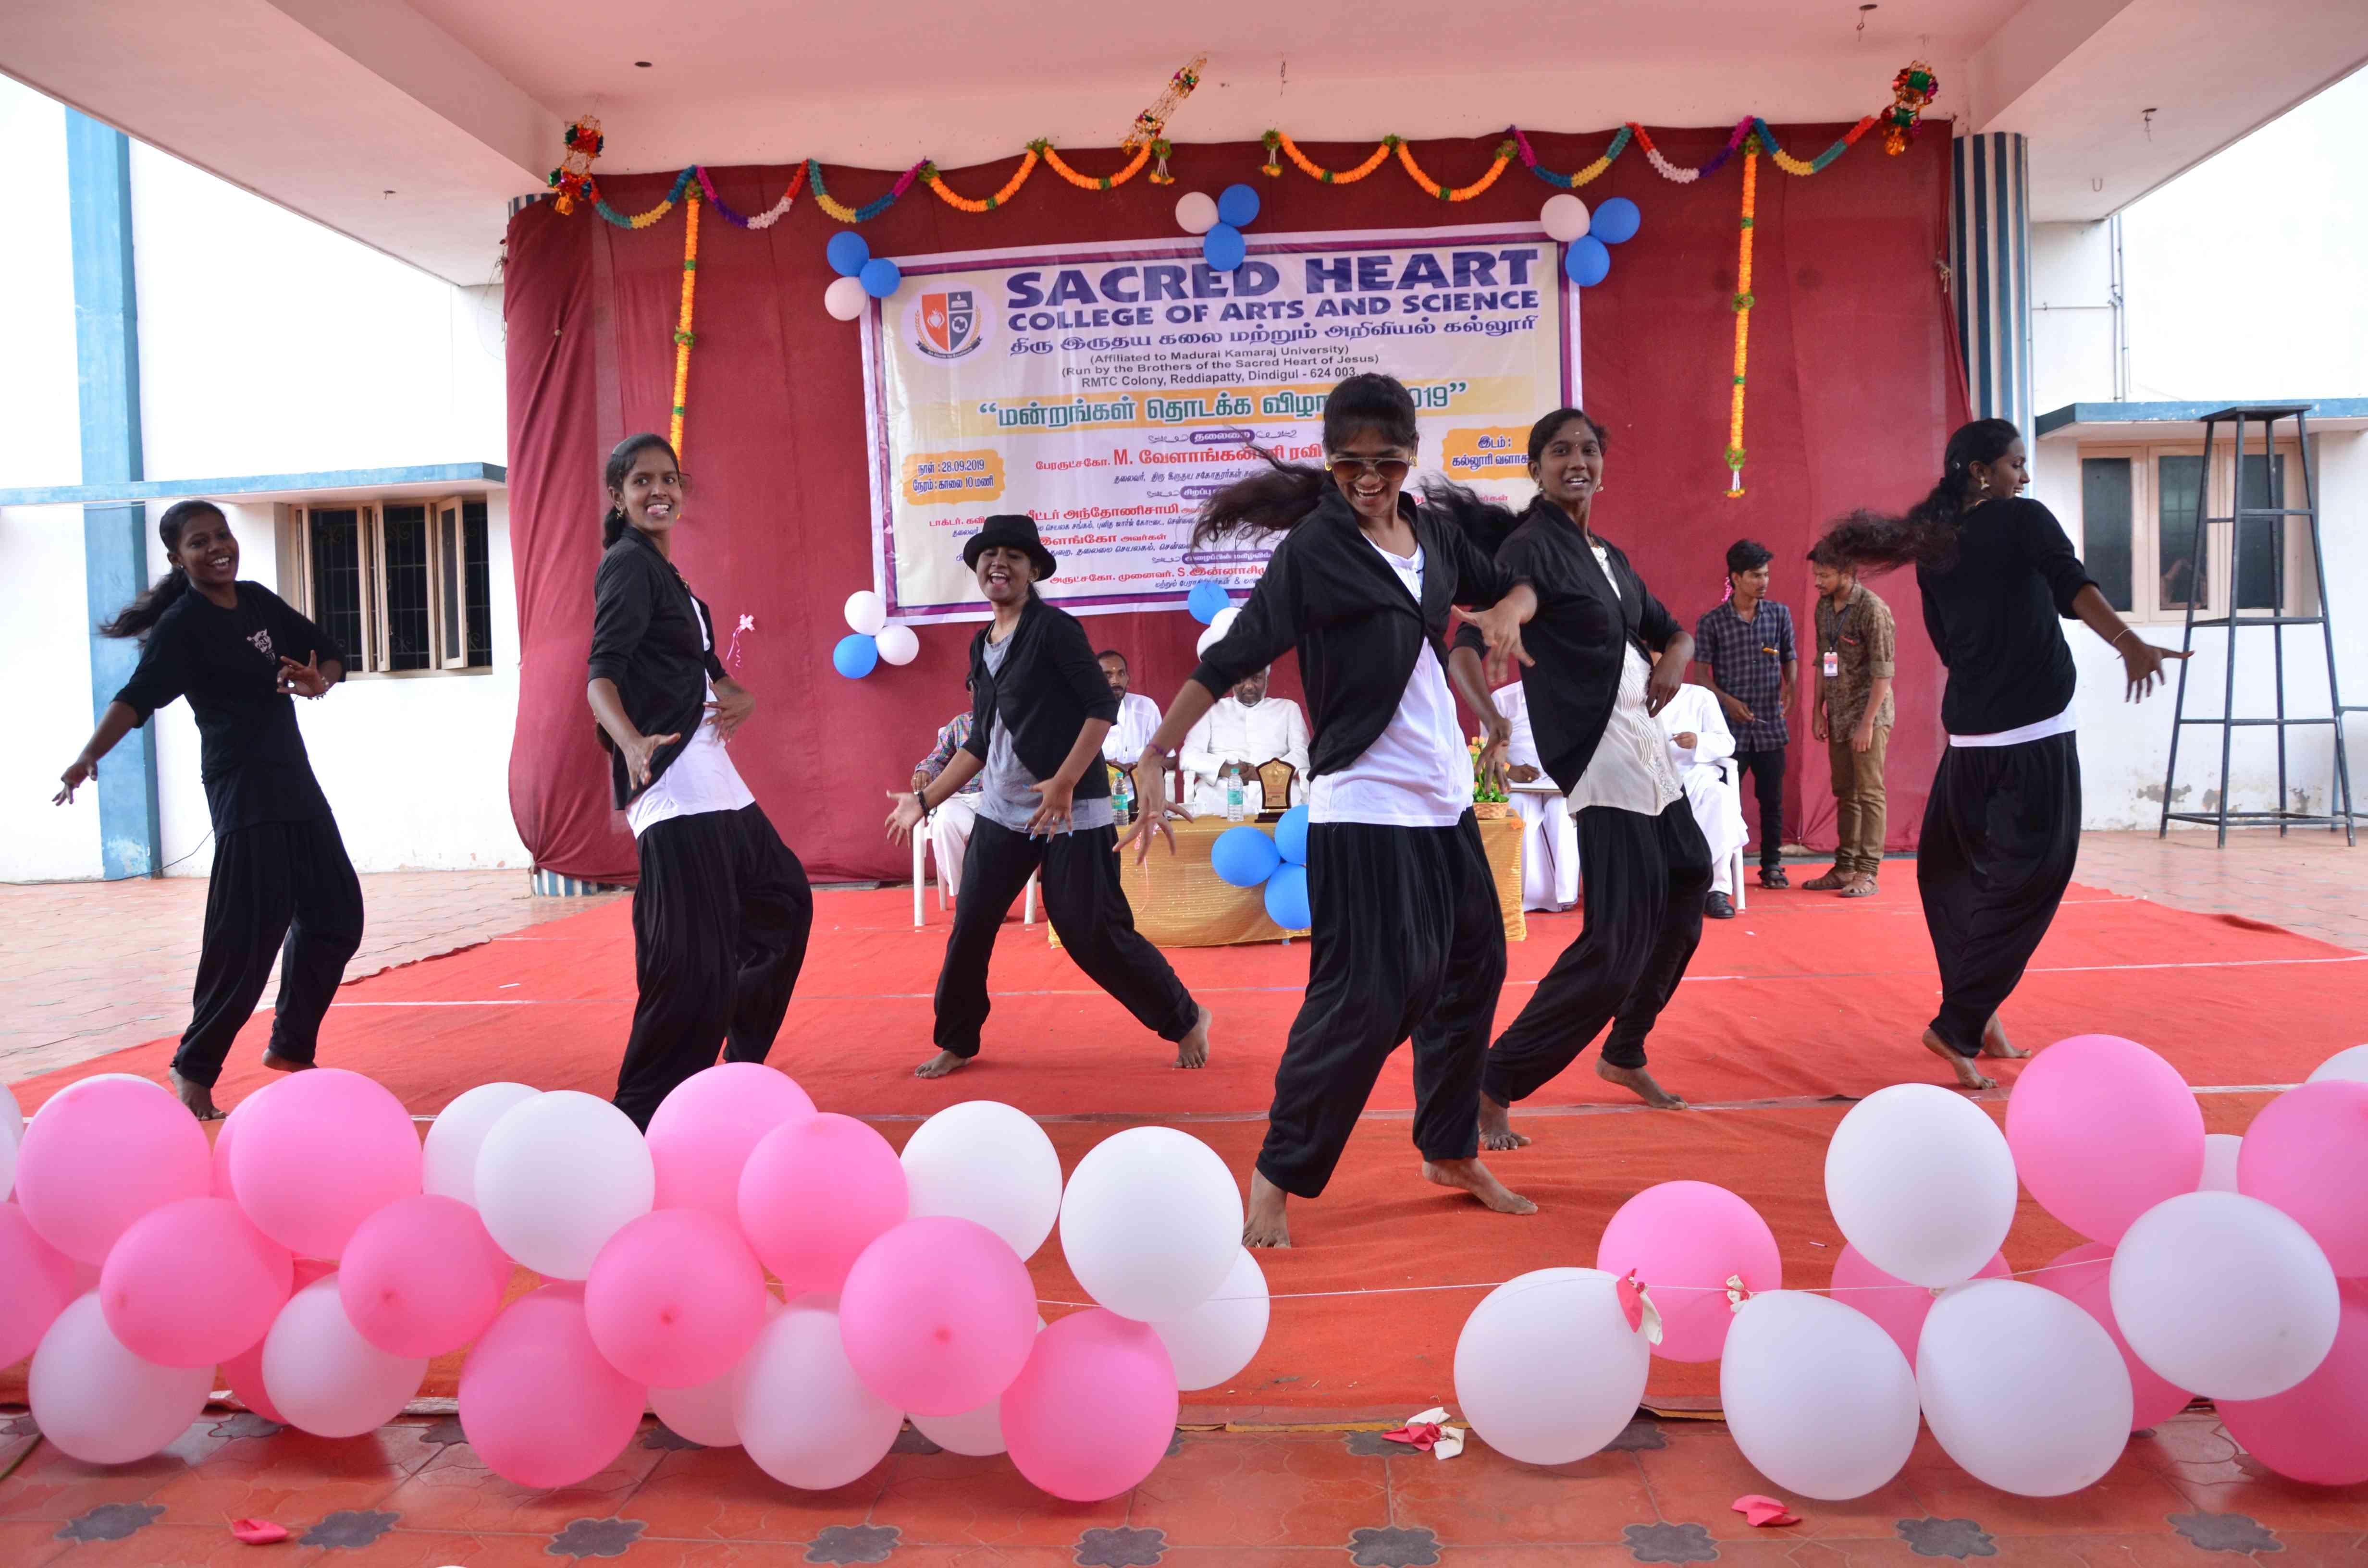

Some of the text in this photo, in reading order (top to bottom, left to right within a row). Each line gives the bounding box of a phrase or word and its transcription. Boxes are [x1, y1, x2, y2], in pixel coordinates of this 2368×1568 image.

[1007, 249, 1538, 308] SACRED HEART
[1008, 290, 1539, 331] COLLEGE OF ARTS AND SCIENCE
[1010, 315, 1538, 356] திரு இருதய கலை மற்றும் அறிவியல் கல்லூரி
[1090, 354, 1150, 365] (Affiliated
[1171, 351, 1221, 360] Madurai
[1225, 348, 1277, 358] Kamaraj
[1281, 345, 1349, 355] University)
[1062, 367, 1091, 378] (Run
[1095, 366, 1110, 375] by
[1138, 363, 1192, 372] Brothers
[1196, 361, 1209, 370] of
[1212, 360, 1231, 368] the
[1236, 359, 1280, 368] Sacred
[1284, 357, 1318, 367] Heart
[1321, 356, 1333, 365] of
[1337, 354, 1379, 364] Jesus)
[1082, 376, 1118, 388] RMTC
[1122, 375, 1167, 387] Colony,
[1171, 371, 1245, 384] Reddiapatty,
[1249, 369, 1298, 381] Dindigul
[1310, 368, 1331, 378] 624
[1147, 392, 1251, 422] தொடக்க
[1409, 382, 1466, 408] 019”
[942, 459, 985, 473] 28.09.2019
[1114, 449, 1133, 465] M.
[1452, 453, 1529, 470] கல்லூரி வளாக
[965, 477, 973, 488] 10
[1063, 503, 1179, 519] அந்தோணிசாமி
